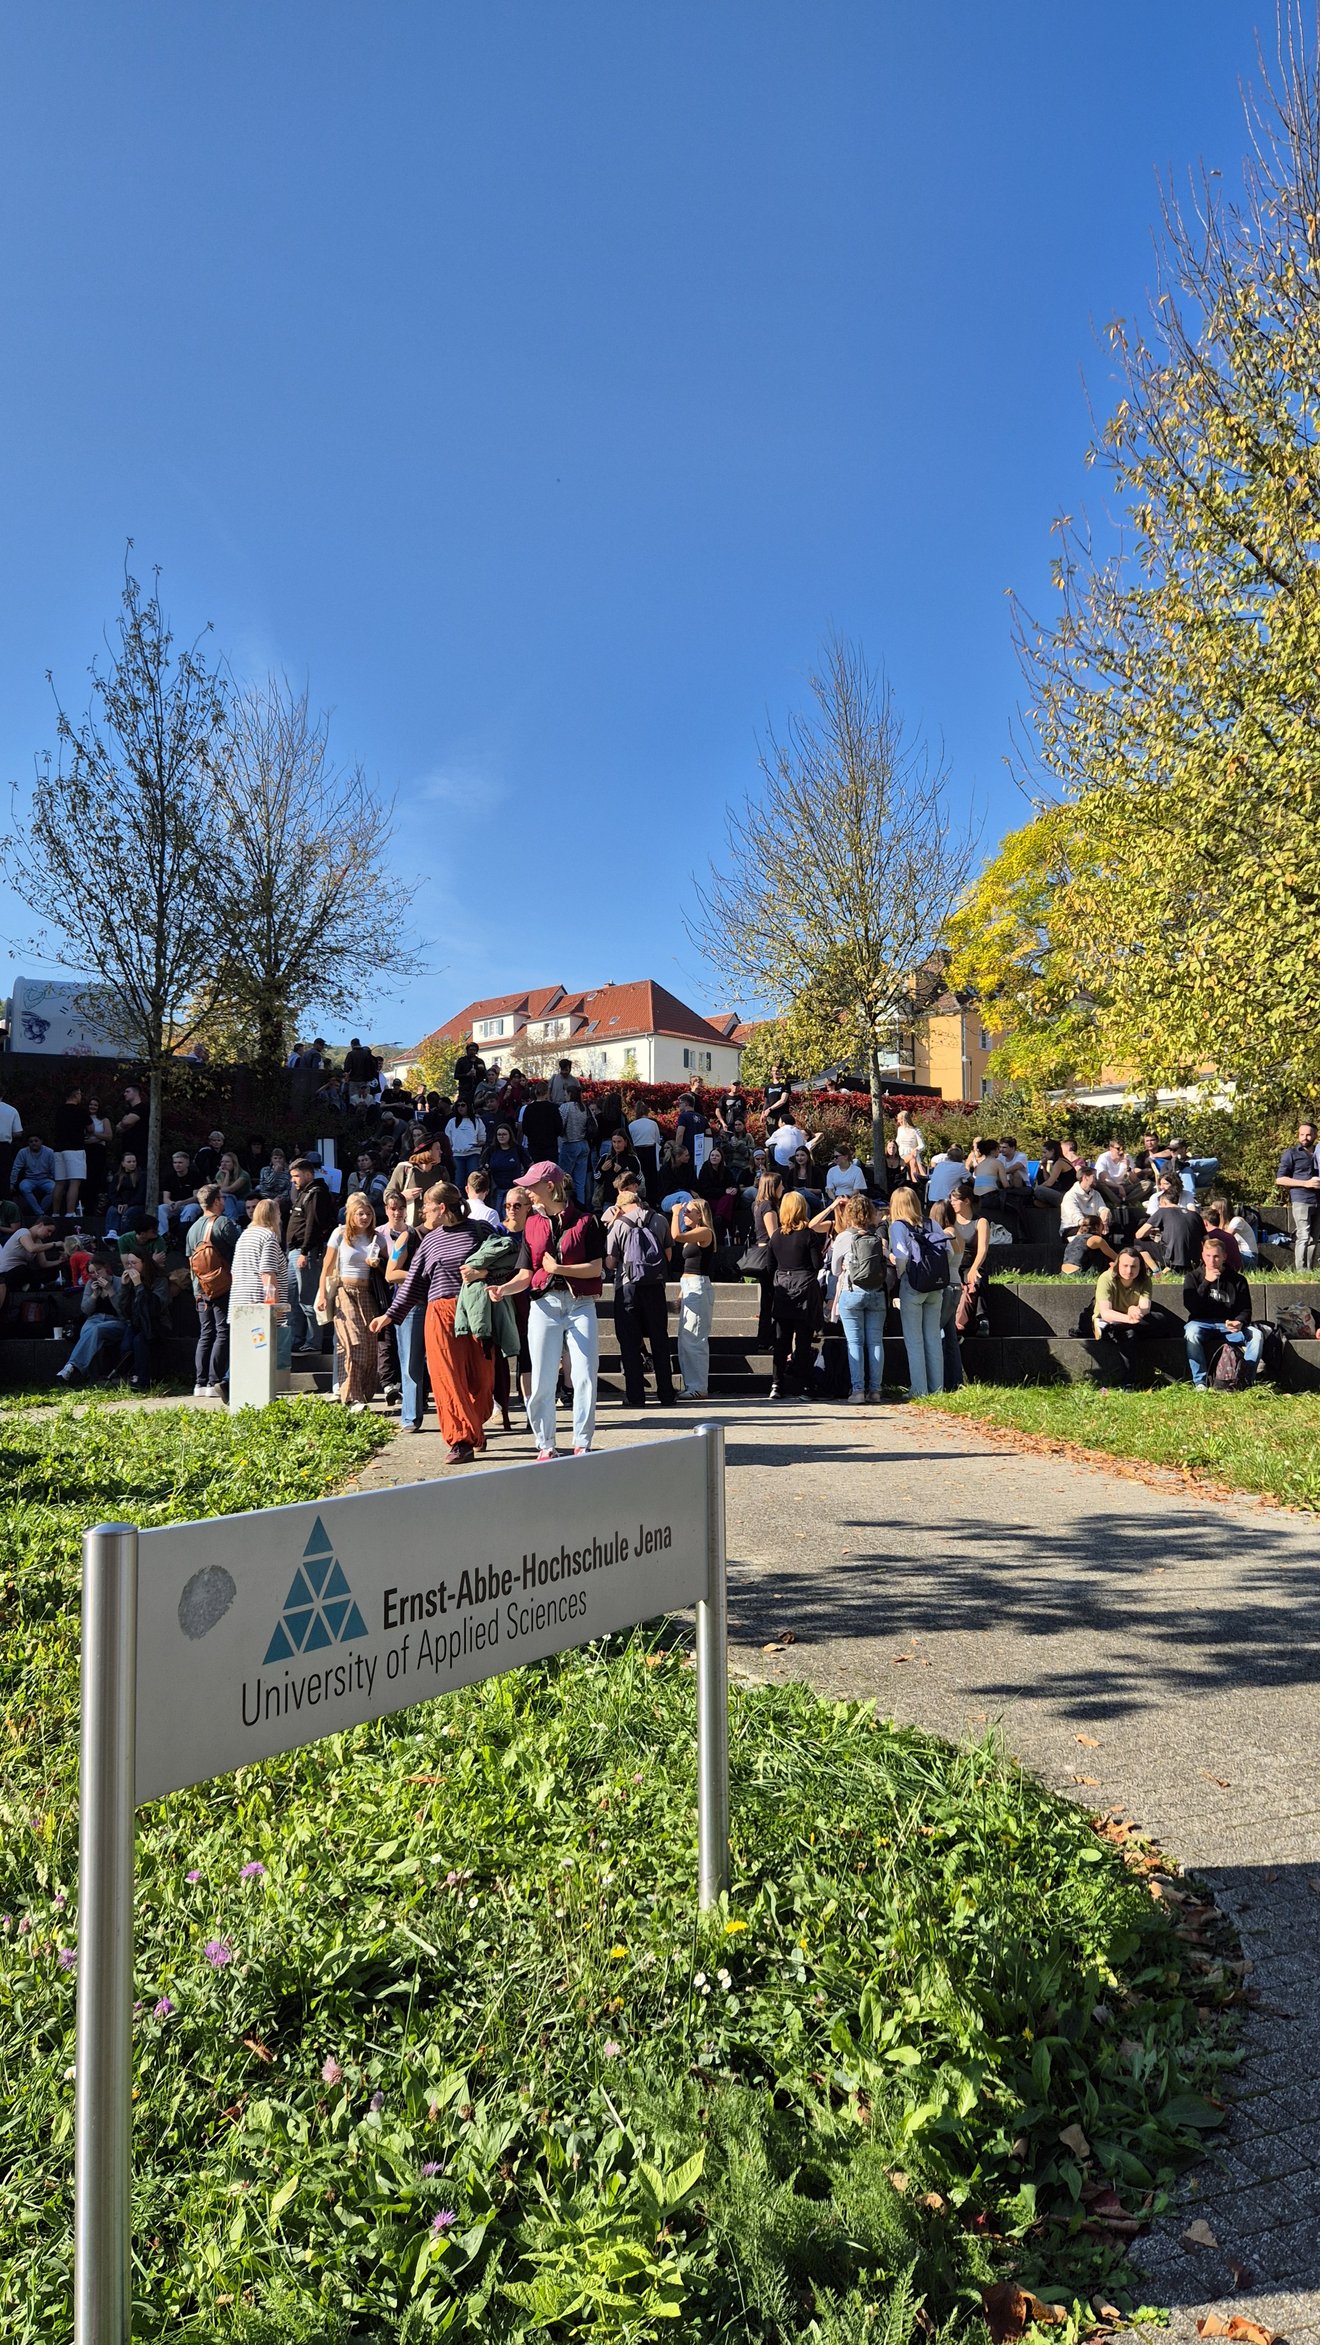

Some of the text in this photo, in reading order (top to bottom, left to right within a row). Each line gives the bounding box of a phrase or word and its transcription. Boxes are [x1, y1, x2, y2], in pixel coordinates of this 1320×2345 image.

[383, 1523, 672, 1630] Ernst-Abbe-Hochschule Jena
[241, 1590, 587, 1727] University of Applied Sciences
